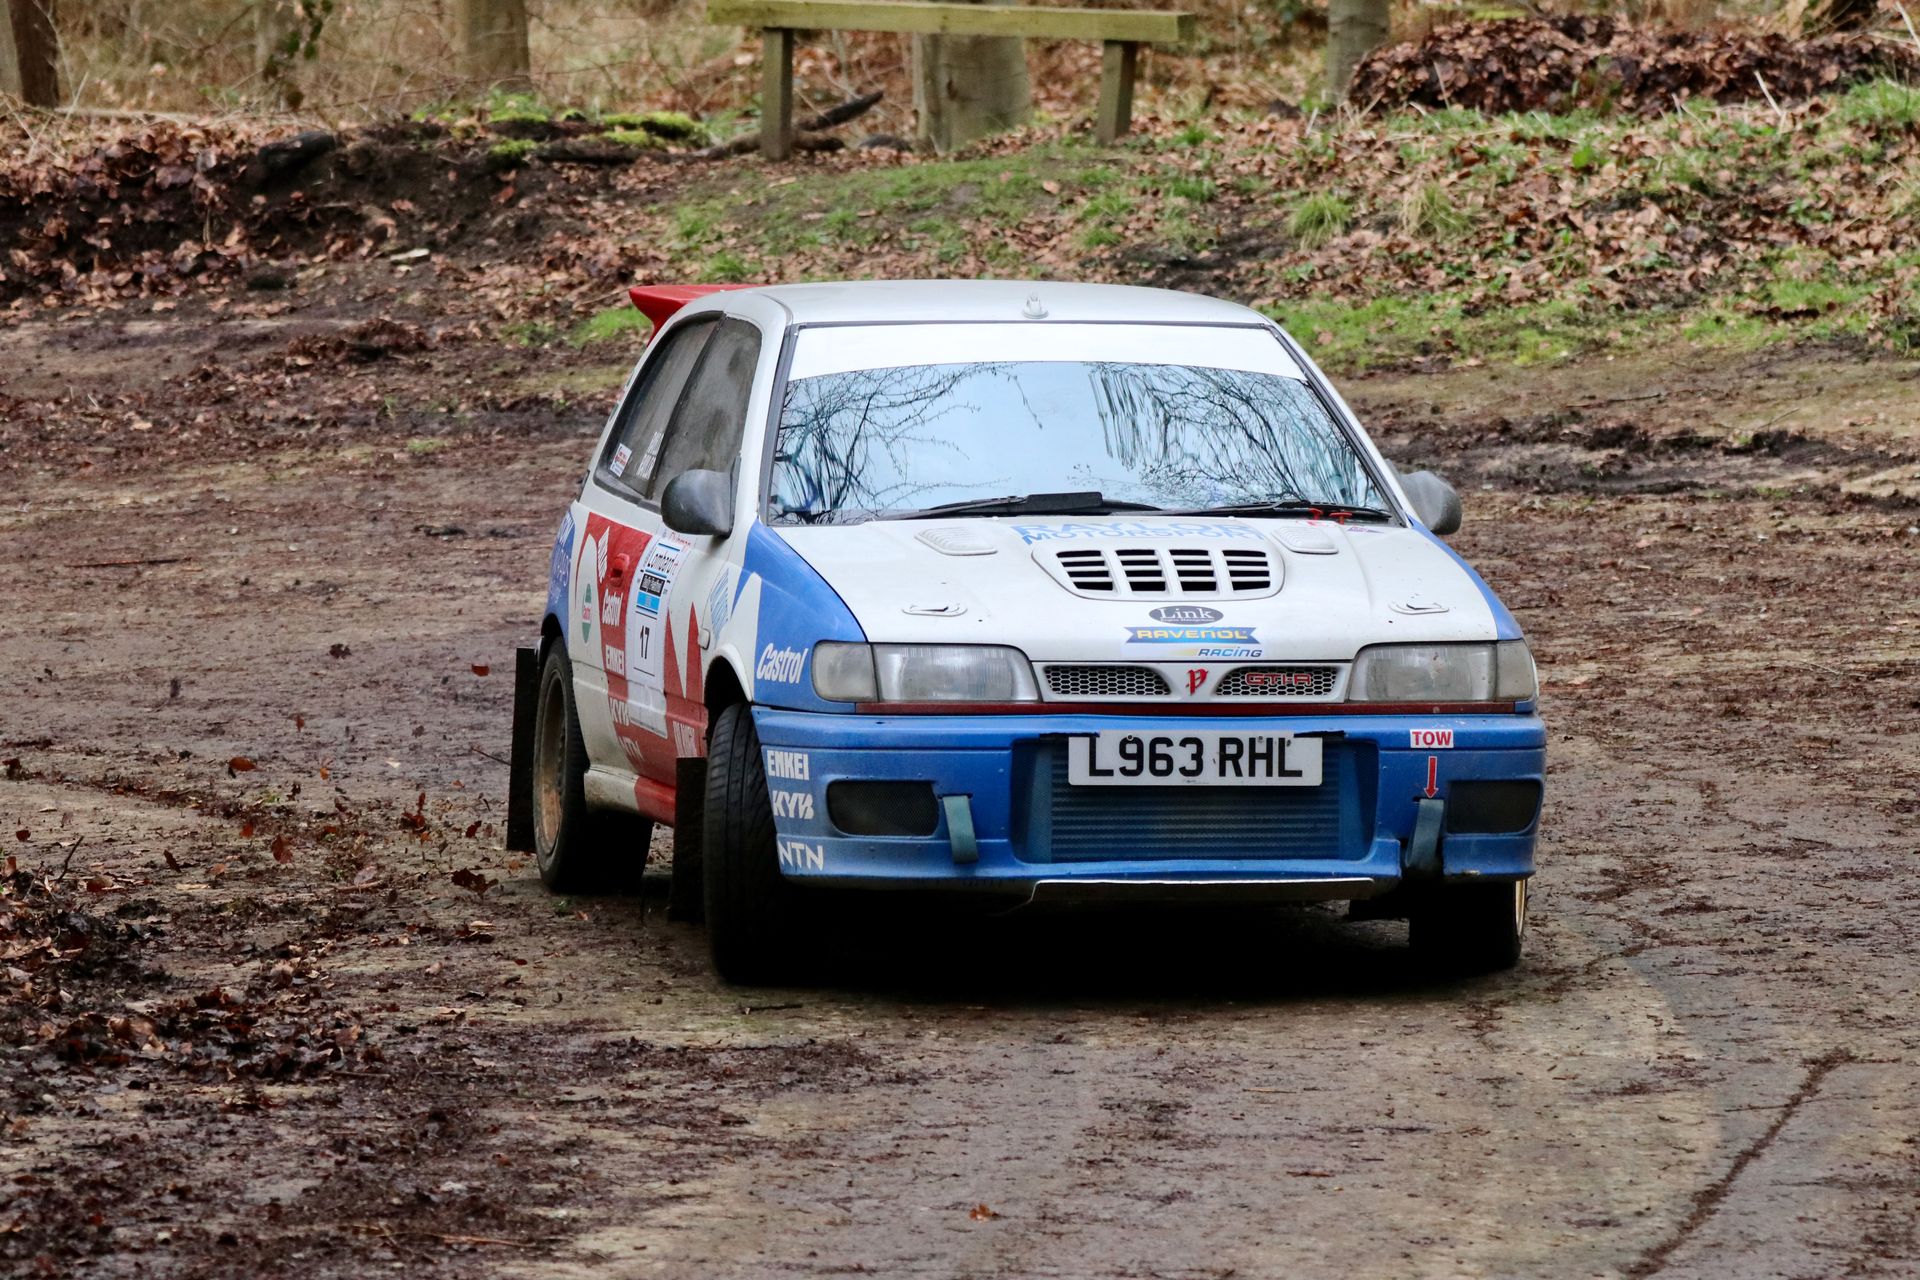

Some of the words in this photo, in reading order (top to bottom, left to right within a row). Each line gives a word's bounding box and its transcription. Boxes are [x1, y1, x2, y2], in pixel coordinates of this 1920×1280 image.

[1022, 529, 1266, 546] MOTORSPORT
[602, 588, 623, 627] Castrol
[1159, 607, 1211, 619] Link
[640, 625, 650, 660] 17
[605, 644, 625, 676] ENKEI
[756, 642, 809, 684] Castrol
[1244, 672, 1312, 687] GTI-R
[1411, 731, 1452, 746] TOW
[766, 750, 810, 781] ENKEI
[1089, 736, 1204, 777] L963
[1218, 737, 1303, 778] RHL
[772, 789, 815, 820] KYB
[777, 841, 825, 872] NTN
